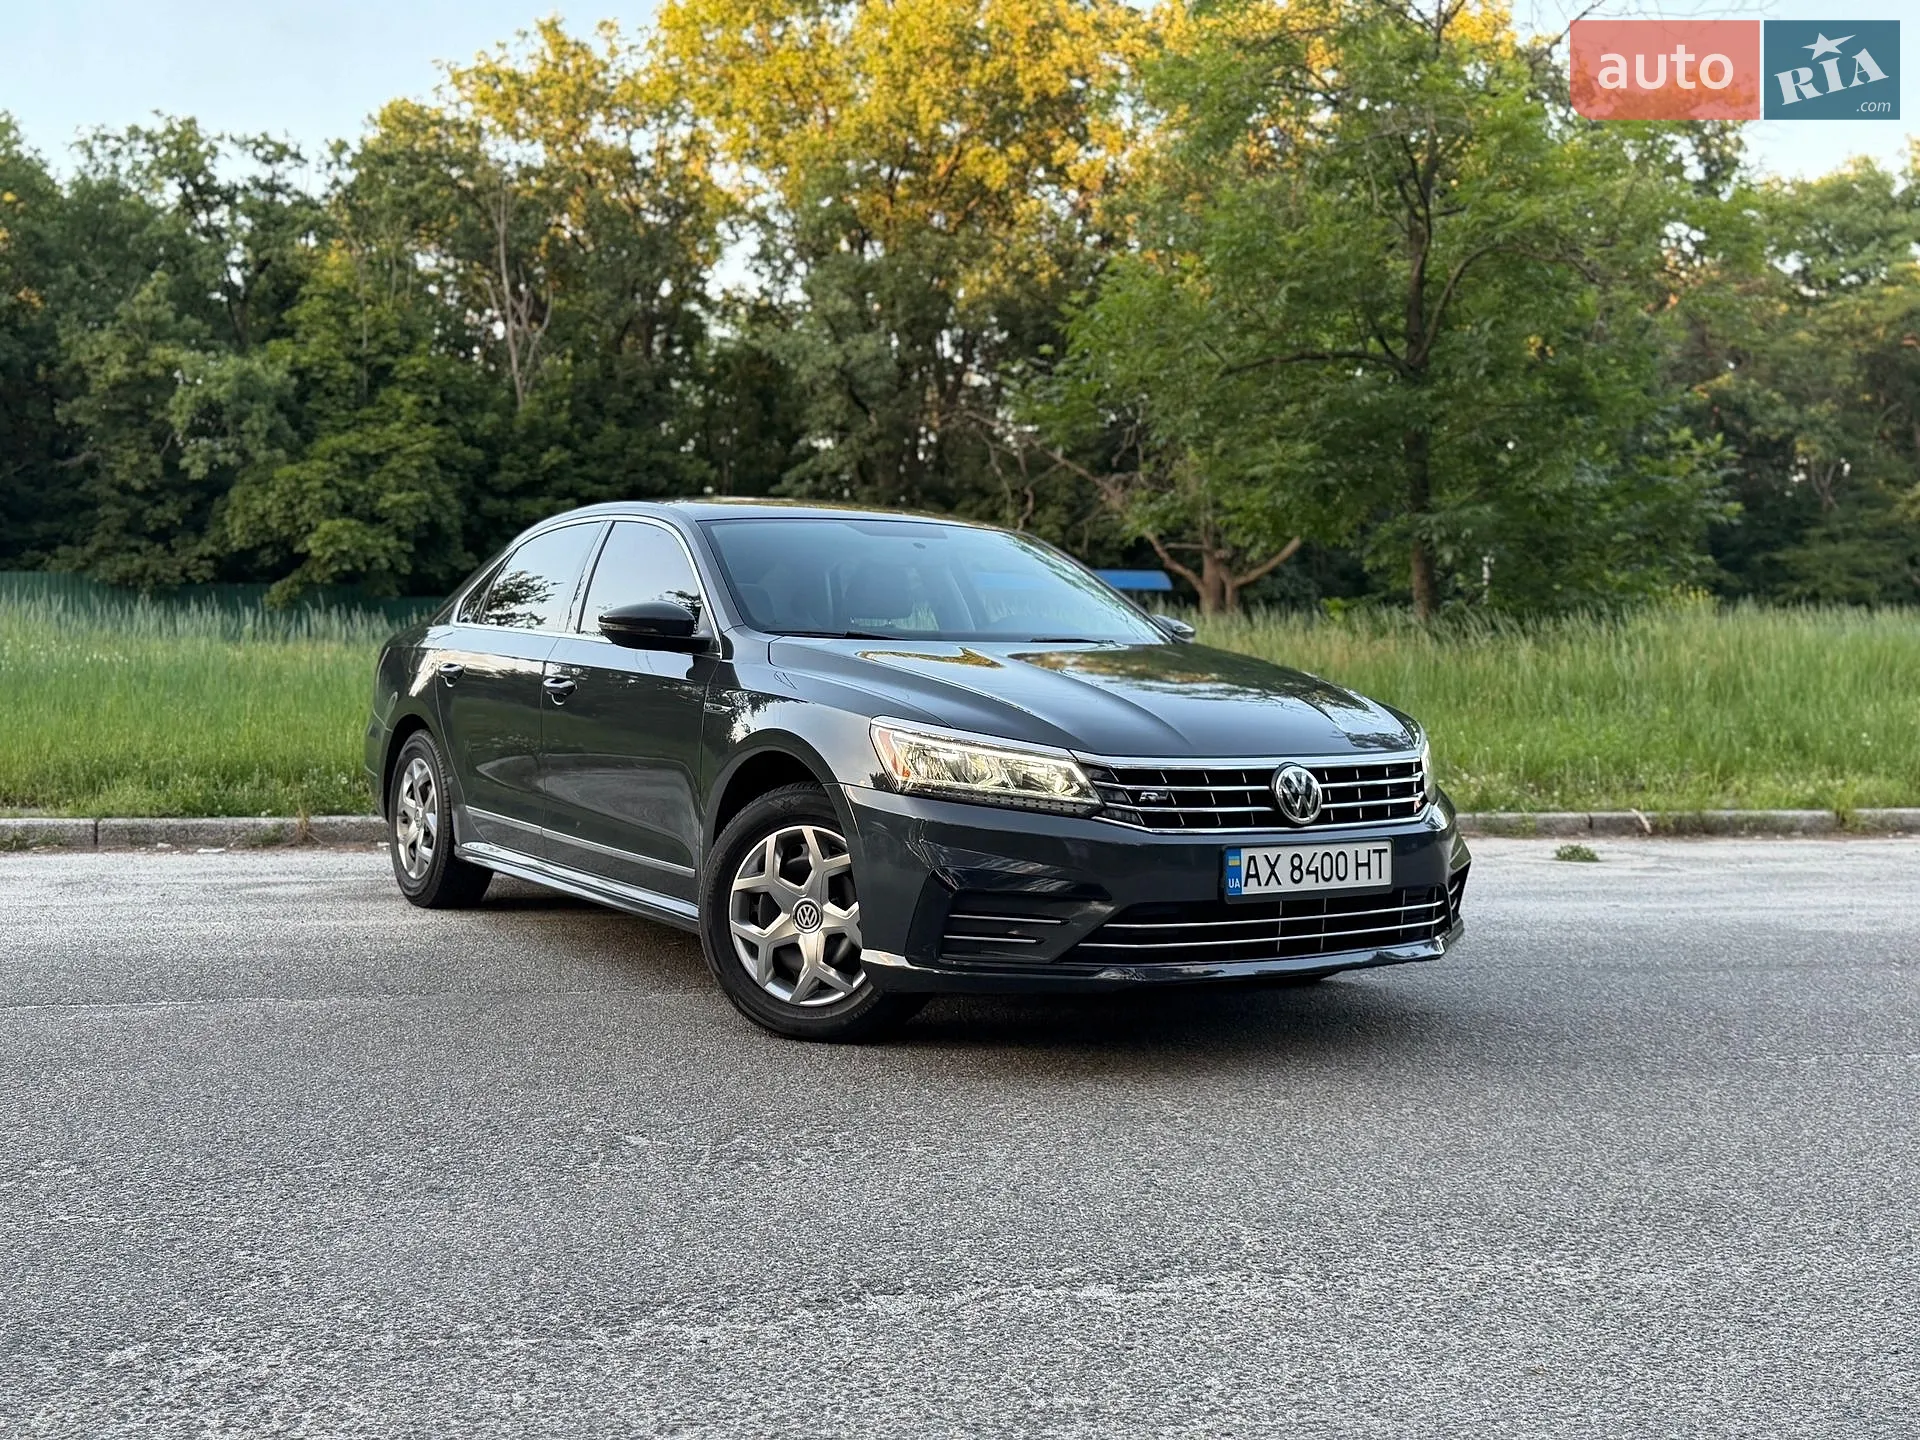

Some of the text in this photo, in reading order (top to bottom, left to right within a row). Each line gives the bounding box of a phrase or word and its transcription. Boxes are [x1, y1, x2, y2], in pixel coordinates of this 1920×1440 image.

[1243, 848, 1388, 888] AX 8400 HT
[1228, 878, 1240, 889] UA
